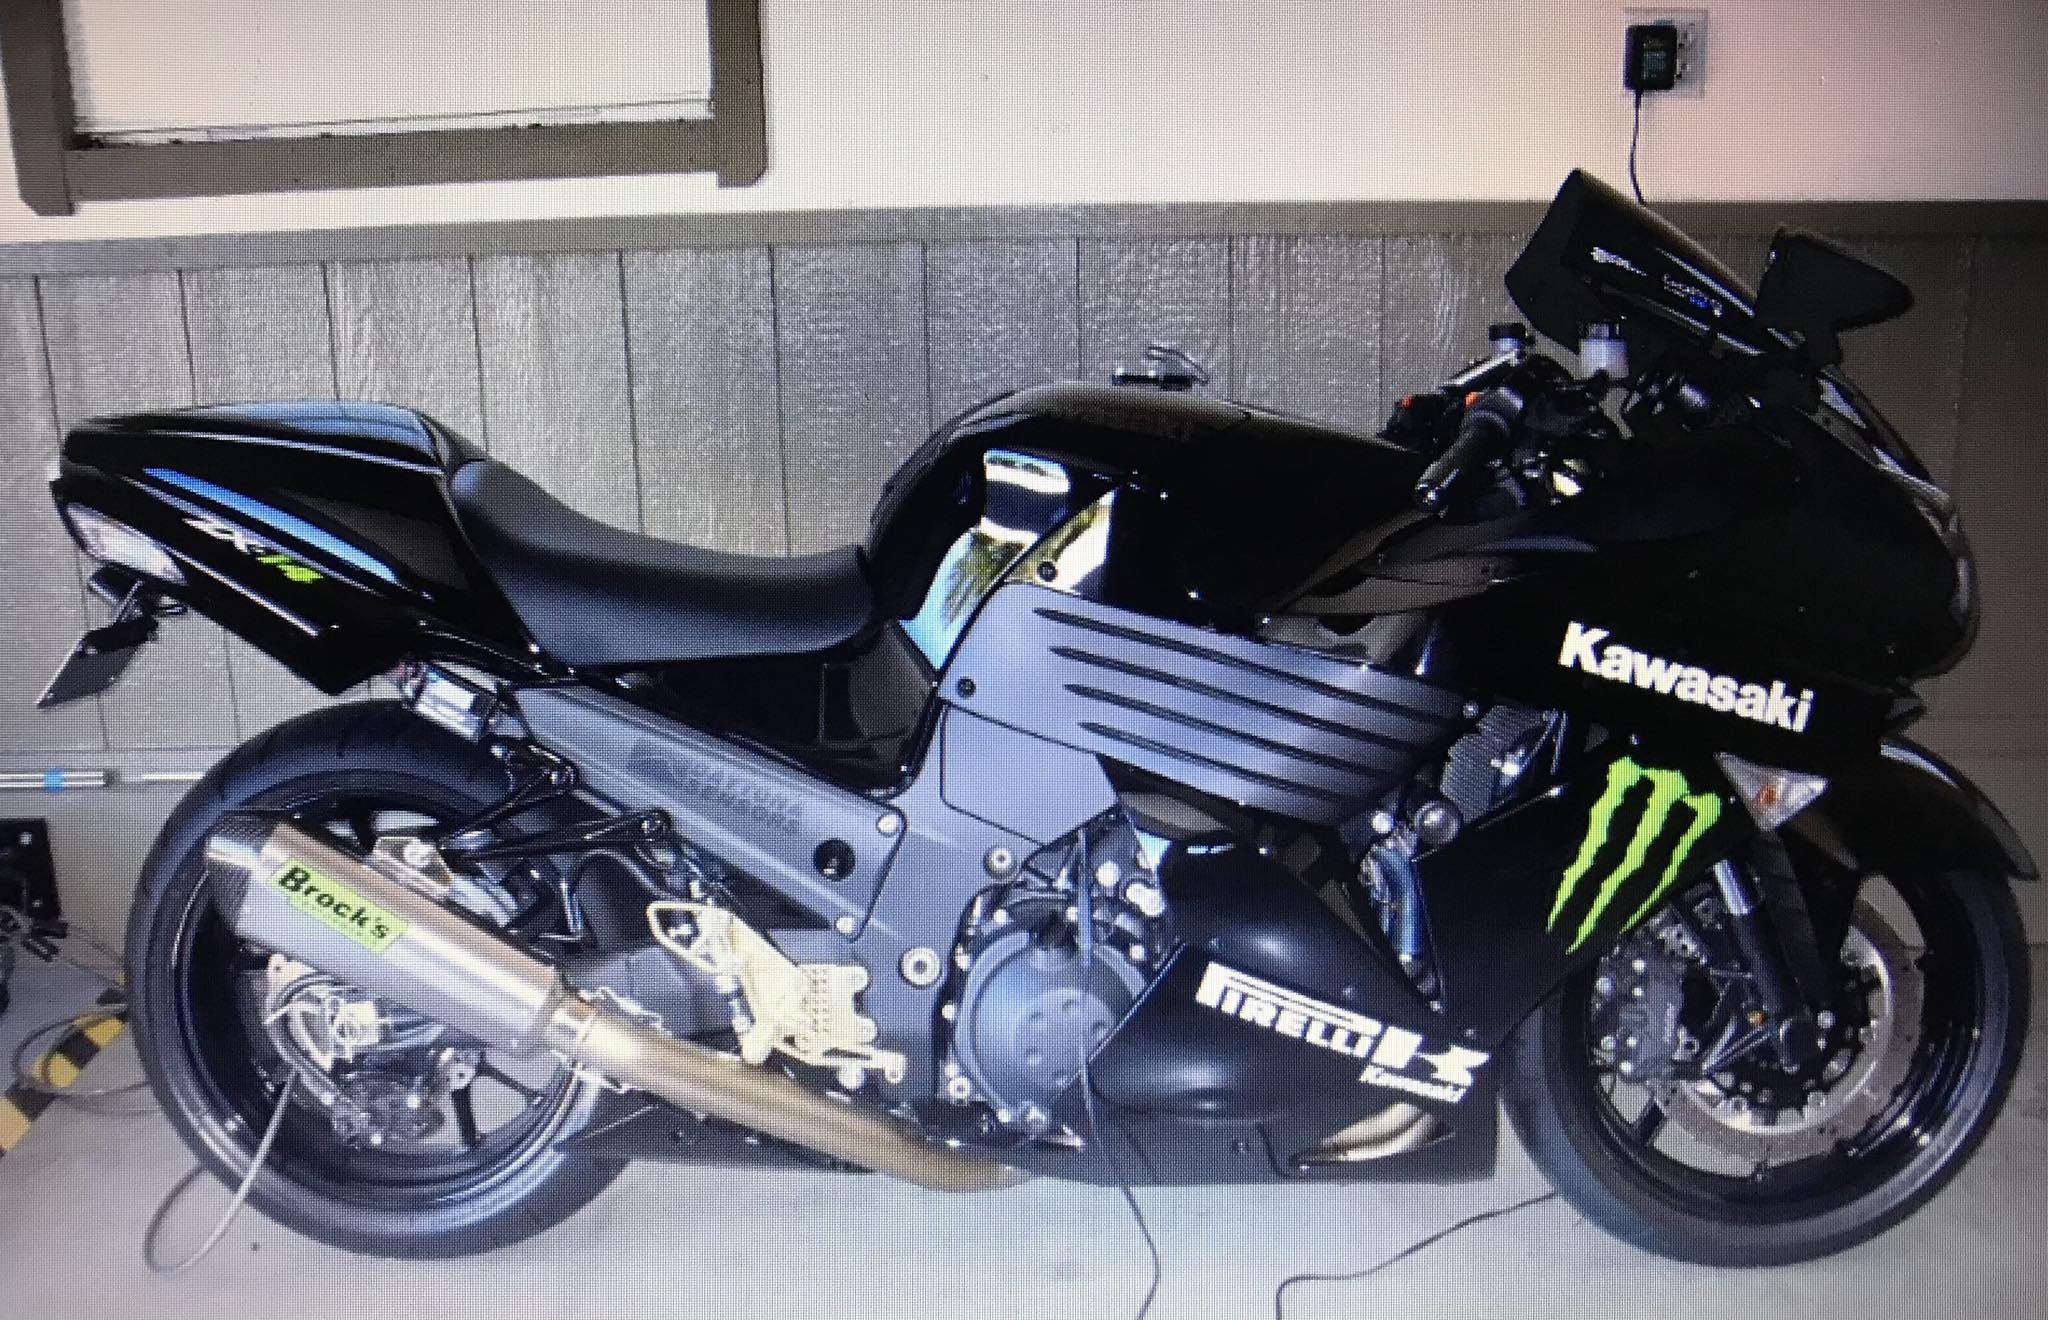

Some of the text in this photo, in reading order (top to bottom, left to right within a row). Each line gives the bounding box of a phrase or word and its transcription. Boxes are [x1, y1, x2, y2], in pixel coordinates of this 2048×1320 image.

[1558, 620, 1815, 733] Kawasaki
[683, 778, 802, 836] SENSORS
[688, 762, 804, 817] DAYTONA
[278, 866, 390, 939] Brock's
[1195, 960, 1383, 1059] PIRELLI
